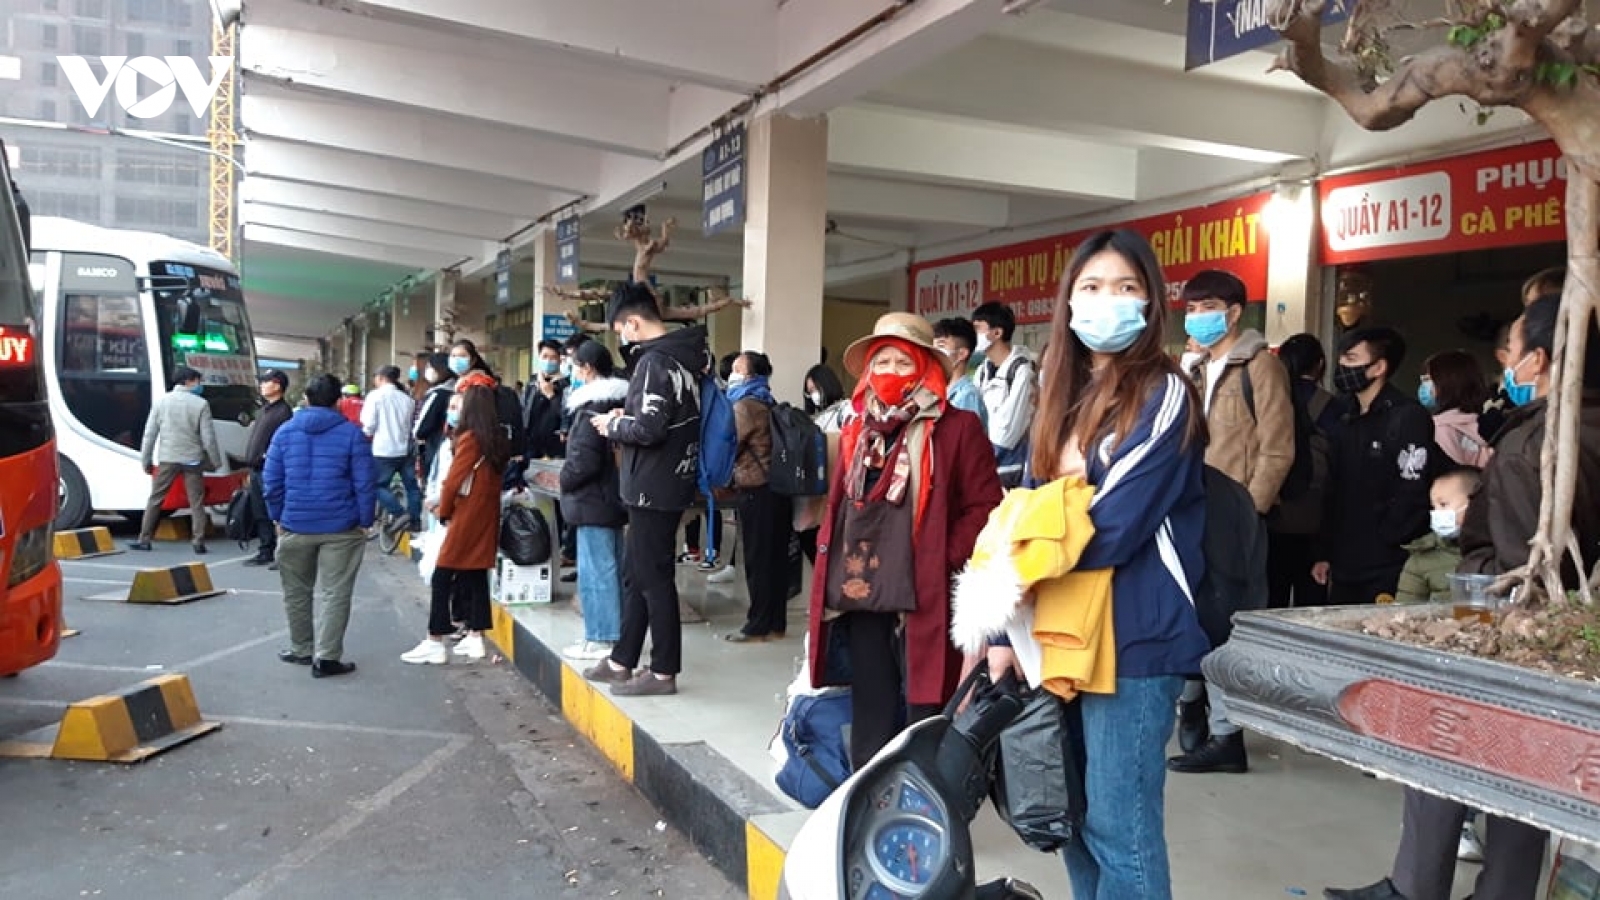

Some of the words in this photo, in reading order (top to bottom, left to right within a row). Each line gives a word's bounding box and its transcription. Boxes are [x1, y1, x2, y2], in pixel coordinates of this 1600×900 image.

[1387, 193, 1443, 232] A1-12
[1460, 204, 1497, 235] CÀ
[1504, 196, 1561, 231] PHÊ
[990, 255, 1024, 297] DỊCH
[1028, 251, 1048, 291] VỤ
[1151, 214, 1193, 267] GIẢI
[1199, 206, 1262, 262] KHÁT
[946, 279, 980, 312] A1-12
